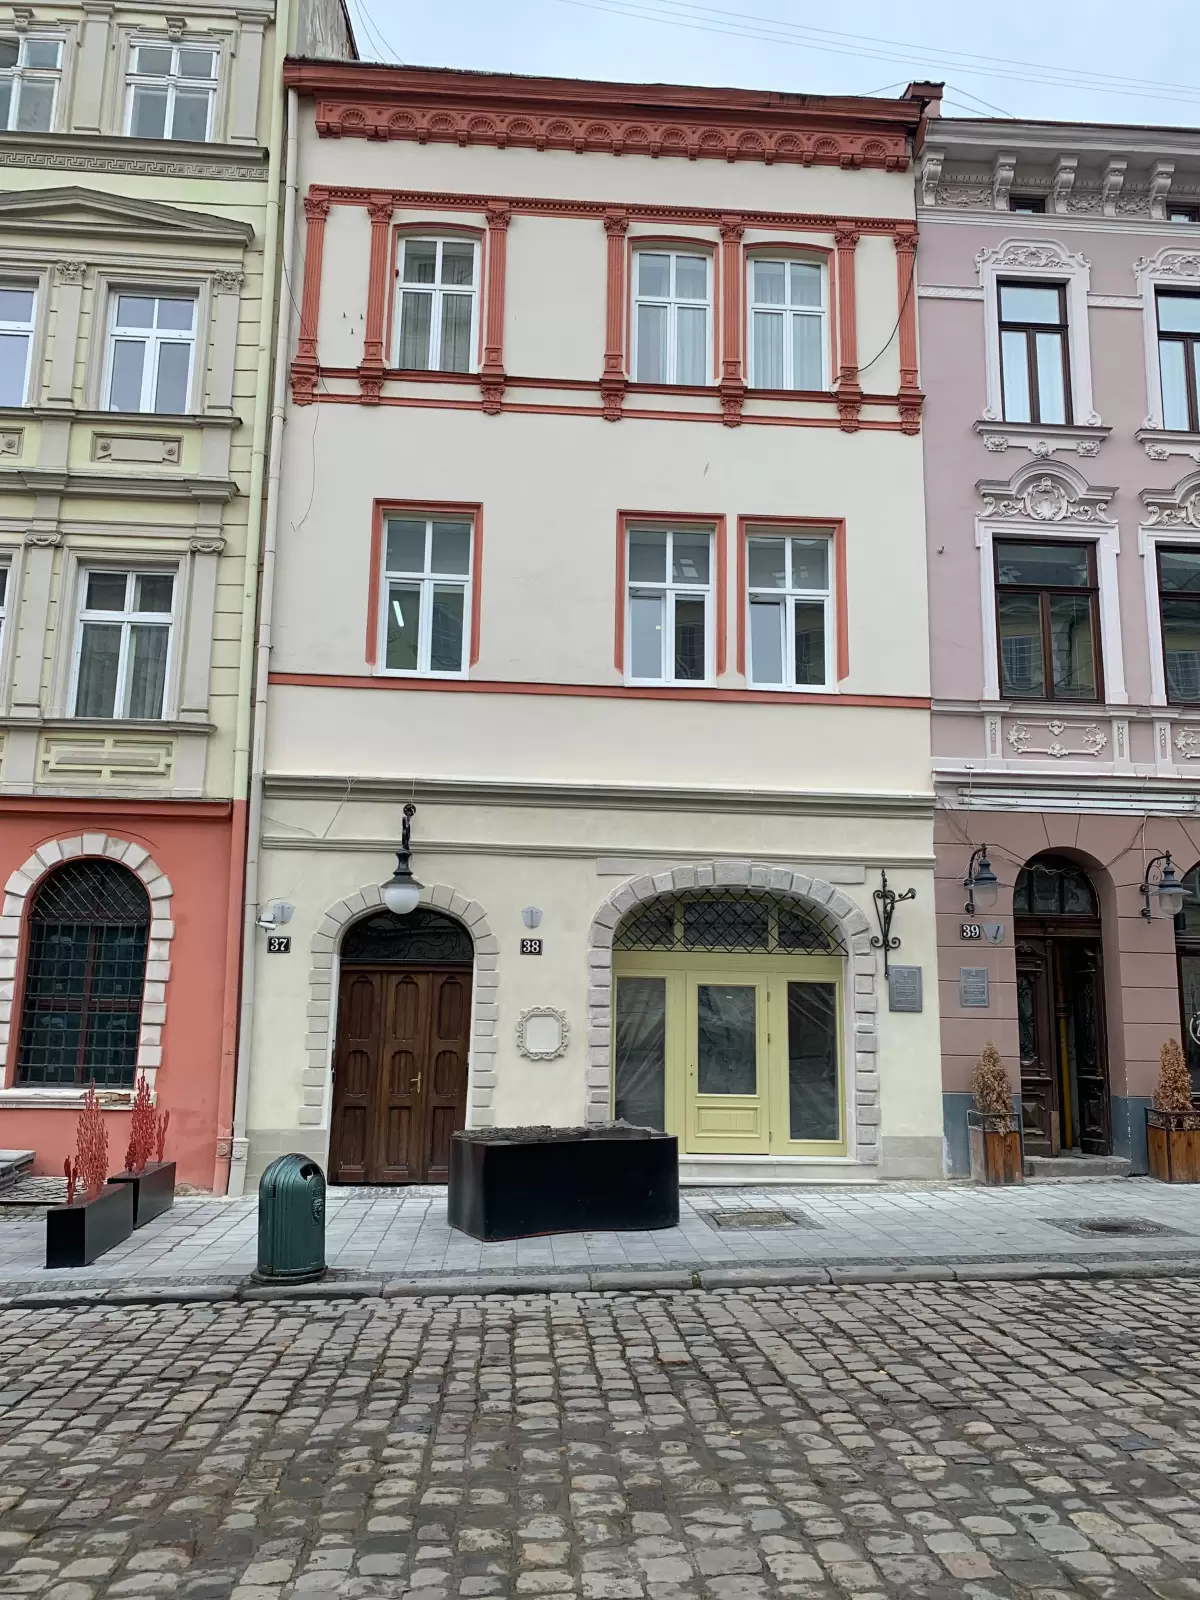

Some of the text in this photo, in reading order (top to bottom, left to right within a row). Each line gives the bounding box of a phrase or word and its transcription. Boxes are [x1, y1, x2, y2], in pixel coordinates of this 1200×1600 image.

[963, 924, 980, 938] 39
[270, 938, 288, 951] 37
[523, 940, 540, 953] 38
